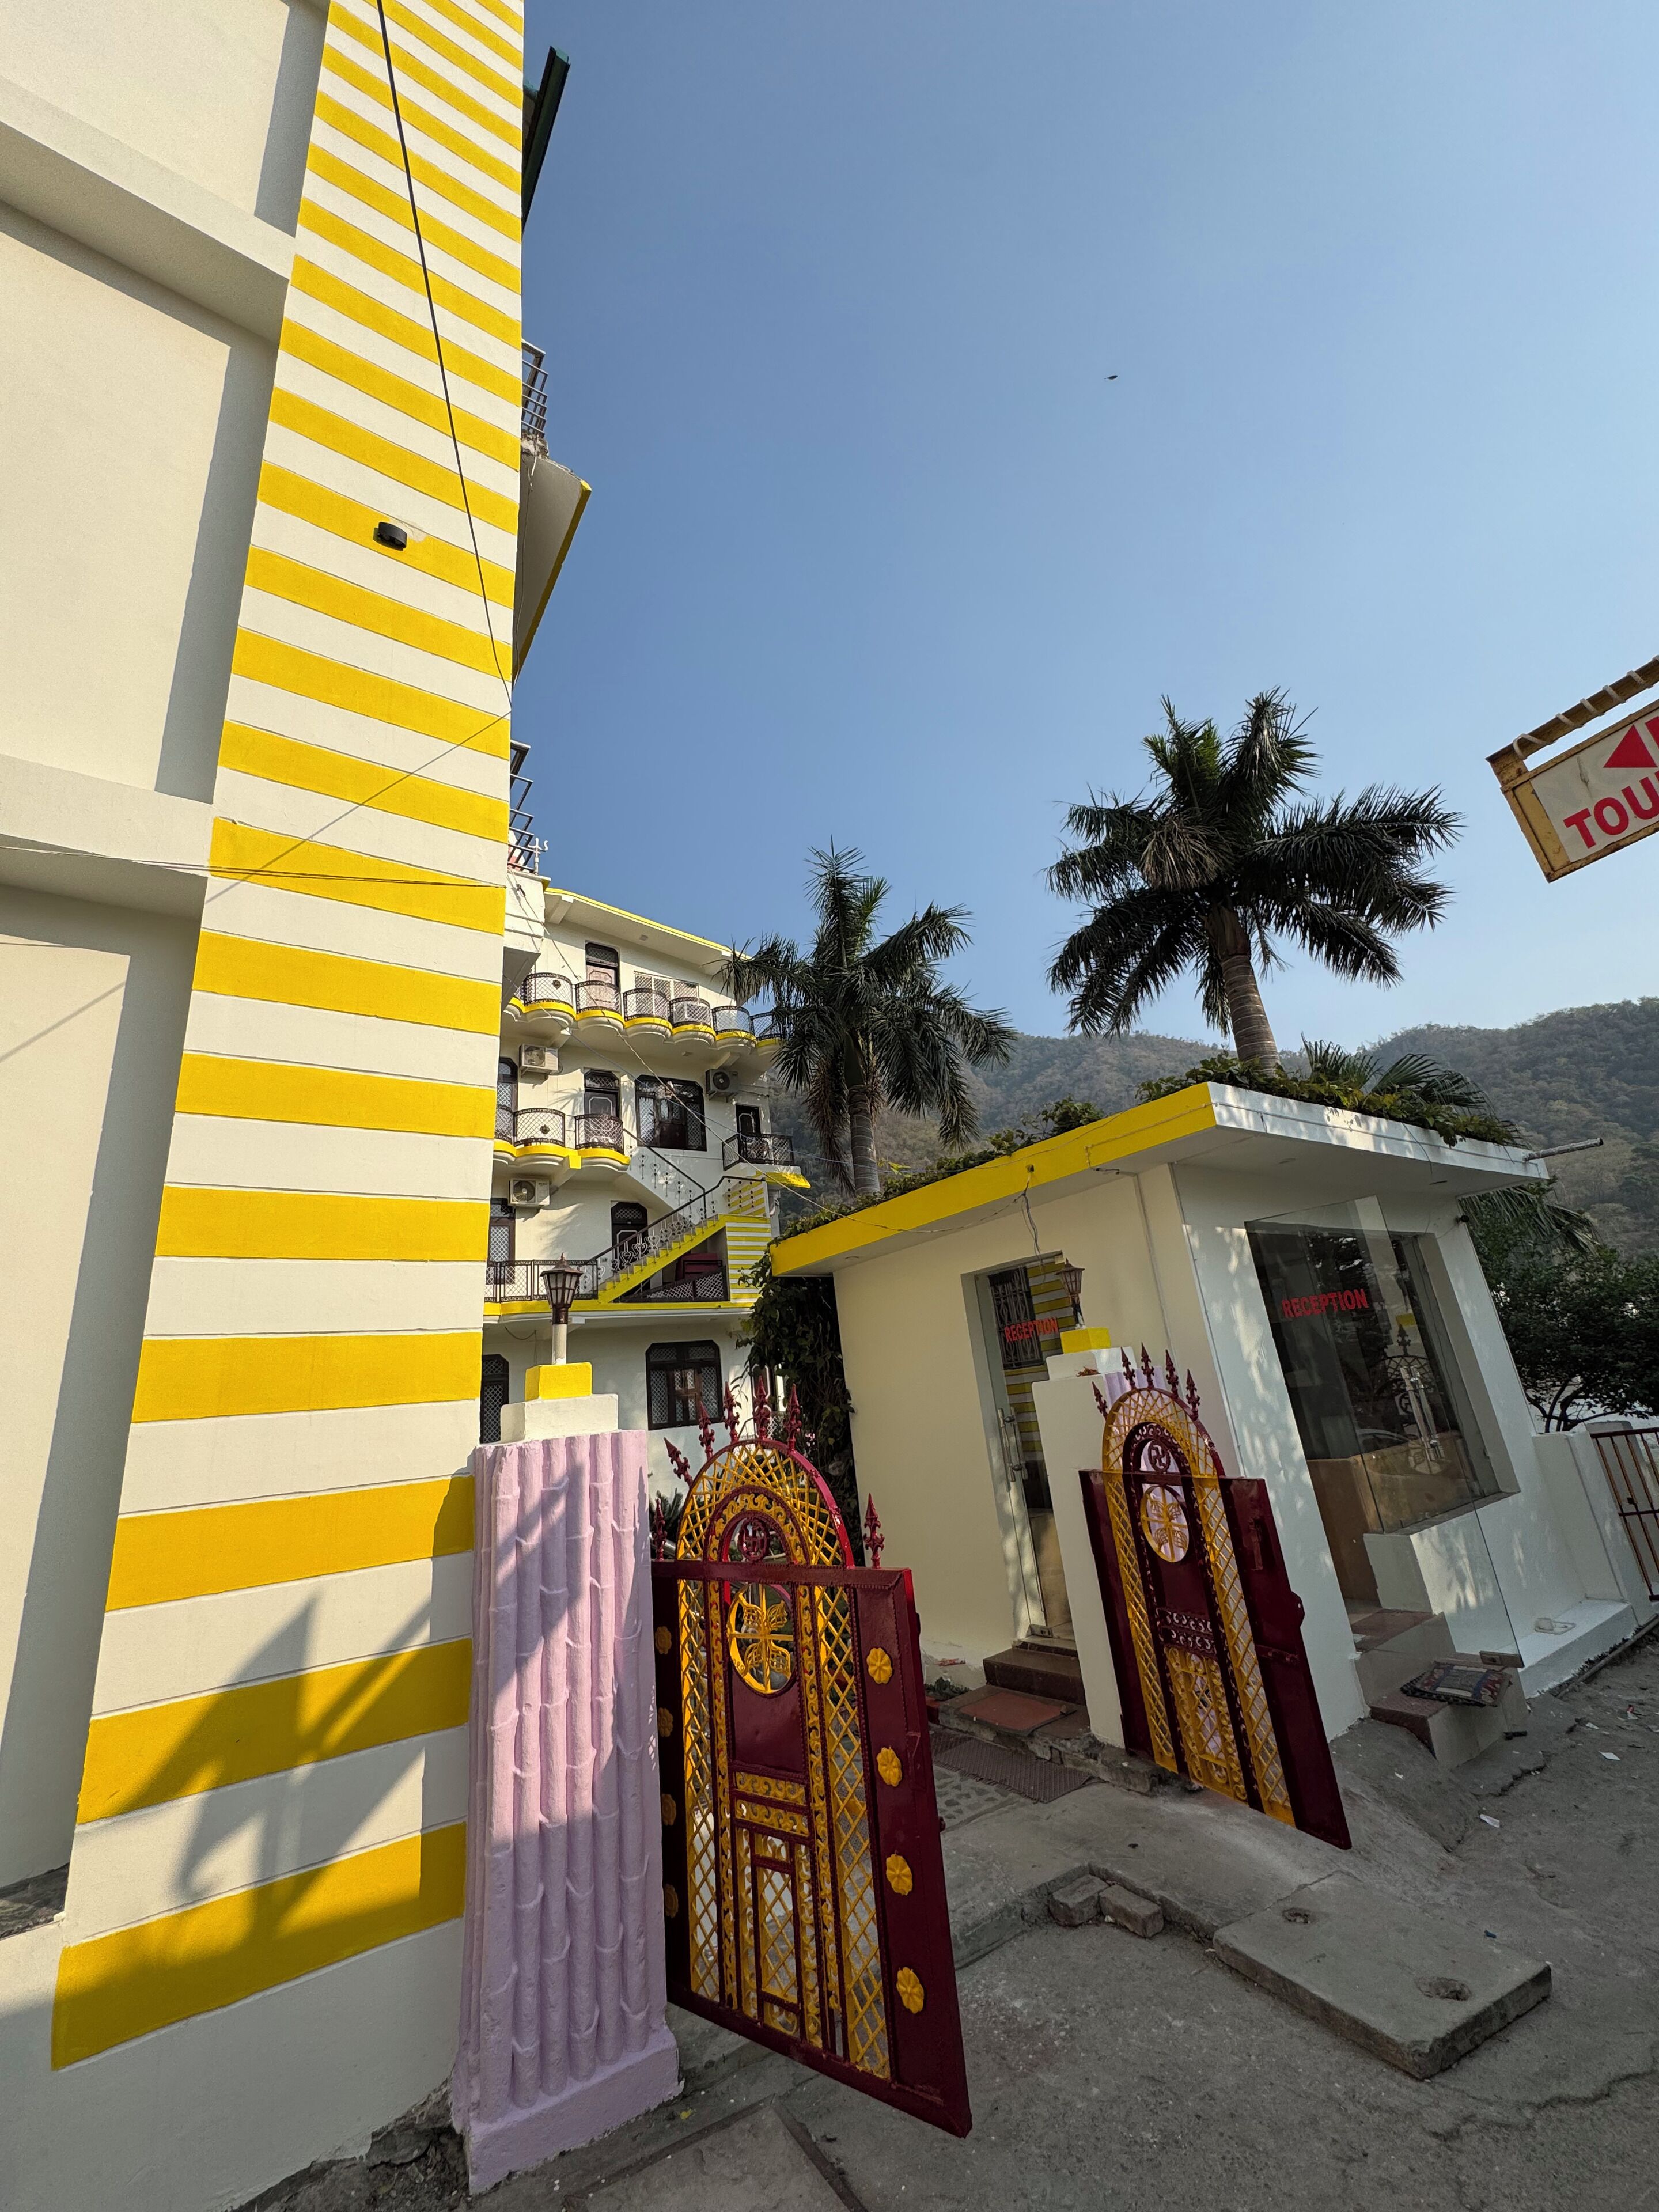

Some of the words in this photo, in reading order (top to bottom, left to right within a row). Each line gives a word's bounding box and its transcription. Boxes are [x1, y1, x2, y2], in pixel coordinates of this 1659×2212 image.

[1563, 770, 1659, 849] TOU
[1282, 1289, 1369, 1318] RECEPTION
[1004, 1317, 1059, 1343] RECEPTION
